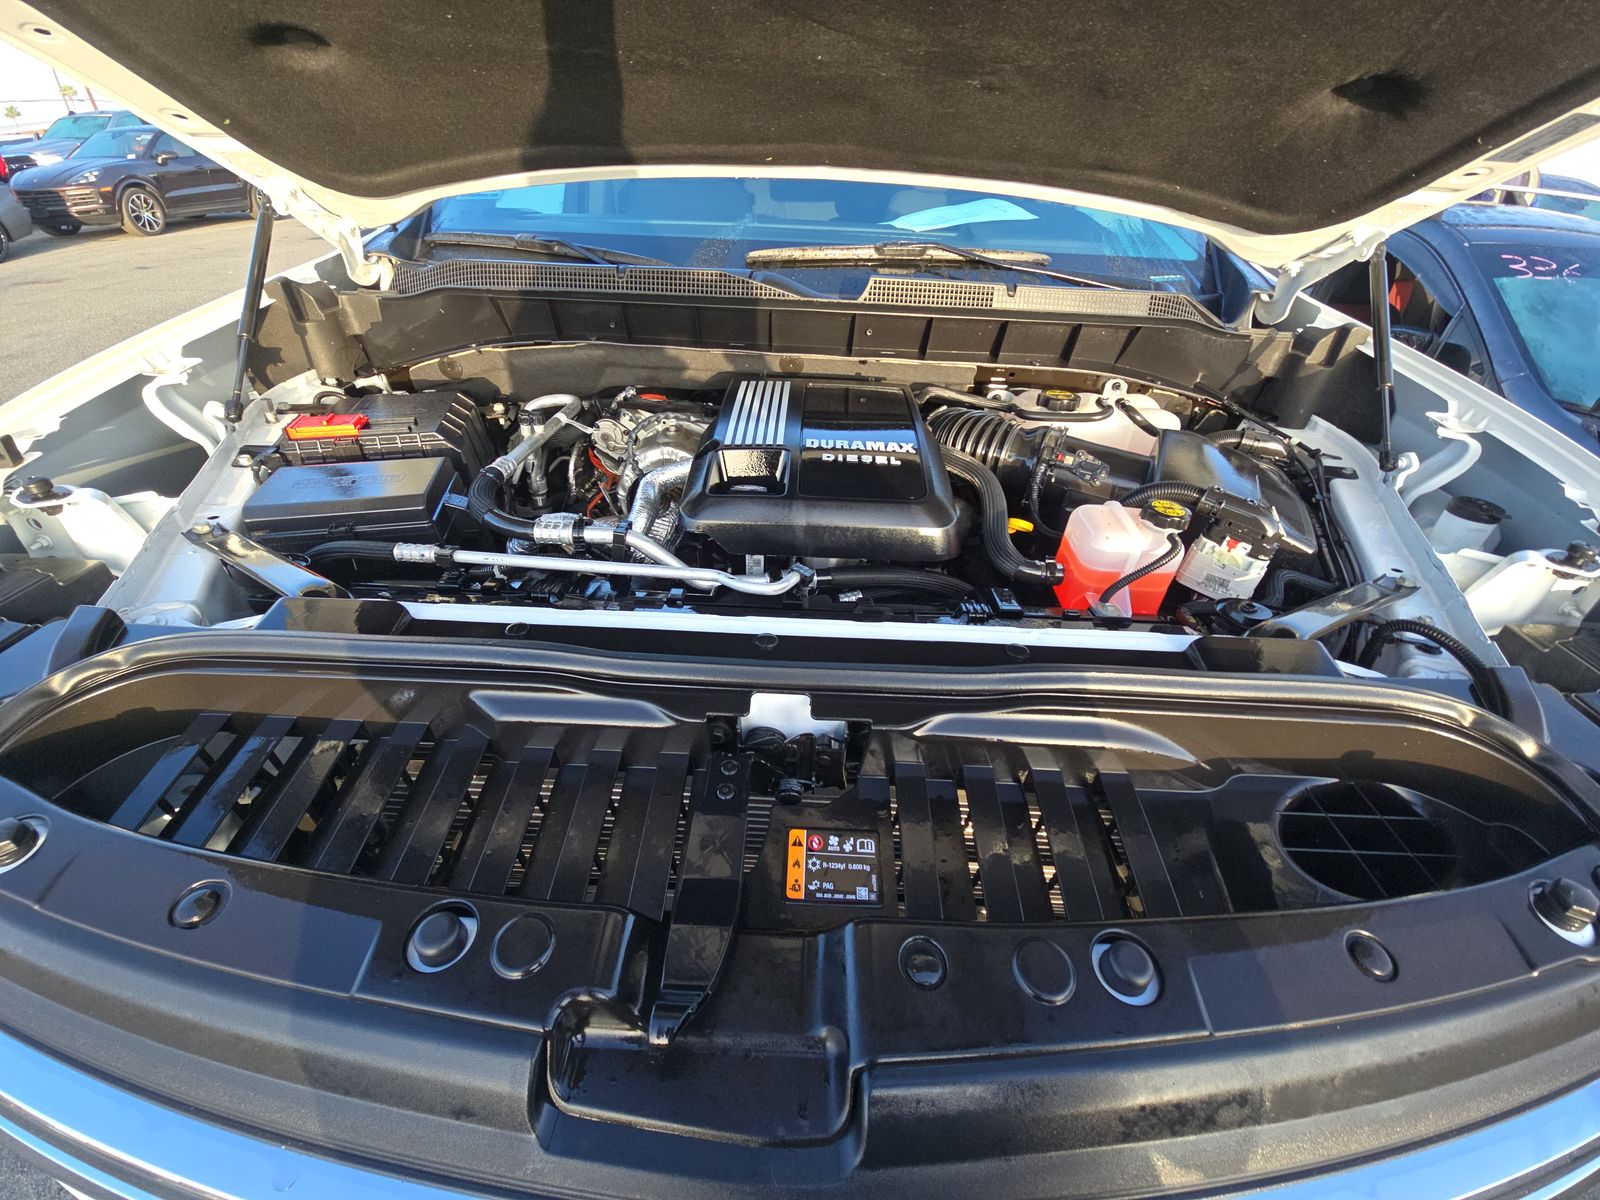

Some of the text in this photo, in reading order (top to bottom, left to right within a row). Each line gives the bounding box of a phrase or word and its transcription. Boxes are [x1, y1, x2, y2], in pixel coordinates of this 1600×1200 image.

[805, 438, 917, 454] DURAMAX
[821, 453, 902, 466] DIESEL
[822, 881, 834, 890] PAG
